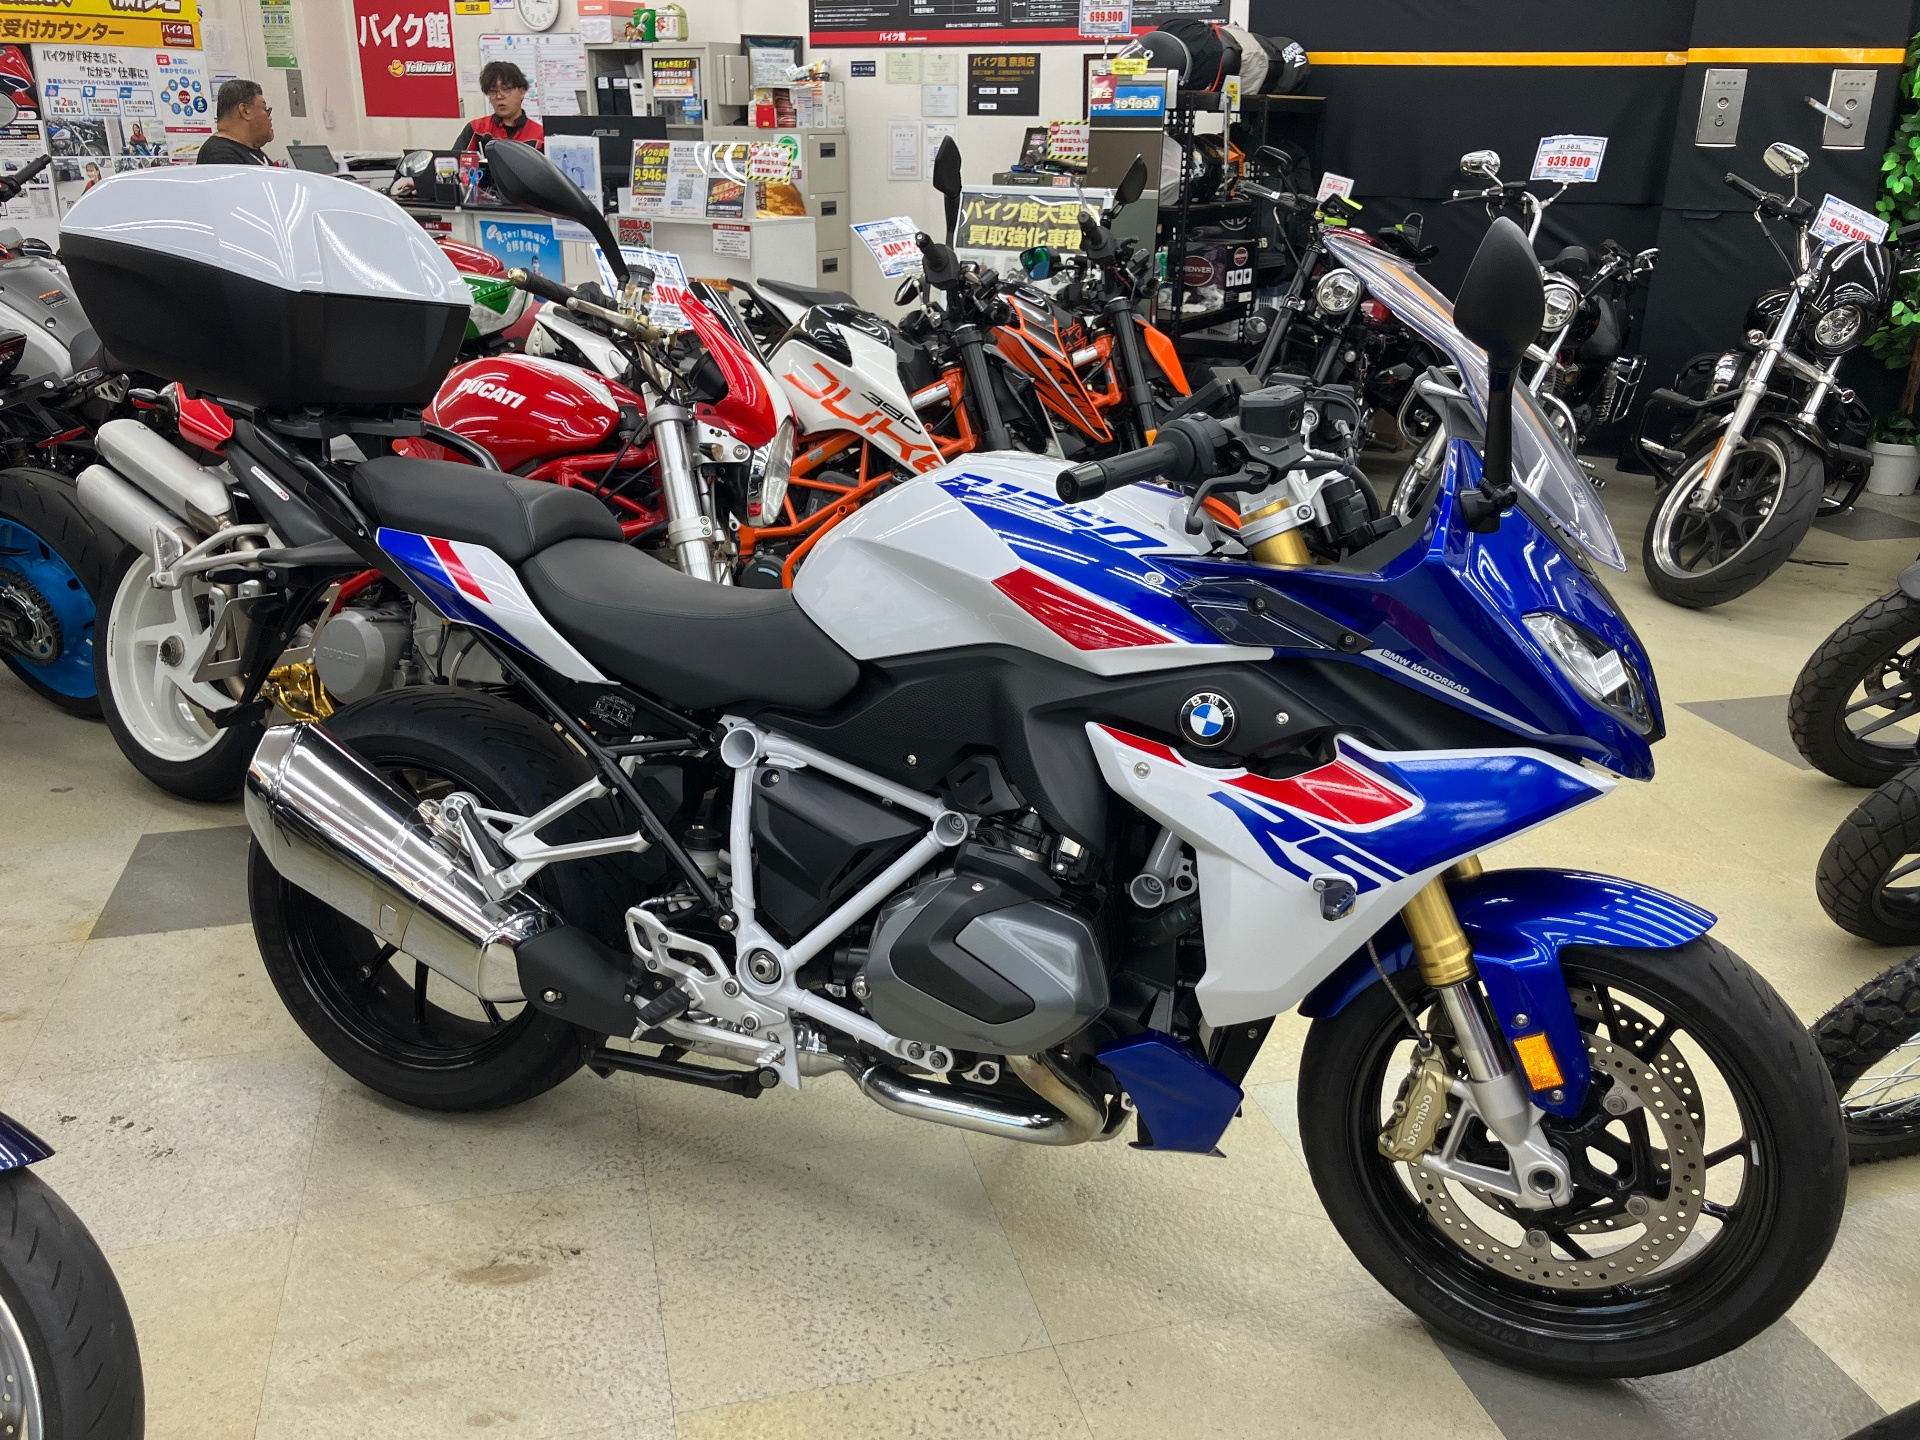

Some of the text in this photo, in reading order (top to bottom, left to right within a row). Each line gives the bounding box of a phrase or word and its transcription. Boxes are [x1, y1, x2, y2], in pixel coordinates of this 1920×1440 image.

[359, 11, 451, 48] バイク館
[1090, 11, 1123, 22] 699,900
[591, 129, 620, 137] ASUS
[1547, 156, 1591, 167] 939,900
[1053, 177, 1070, 185] RK
[455, 378, 527, 409] DUCATI
[1382, 649, 1470, 695] BMW MOTORRAD
[1190, 695, 1233, 718] BMW
[1207, 790, 1405, 895] RS
[1403, 1094, 1433, 1146] brembo
